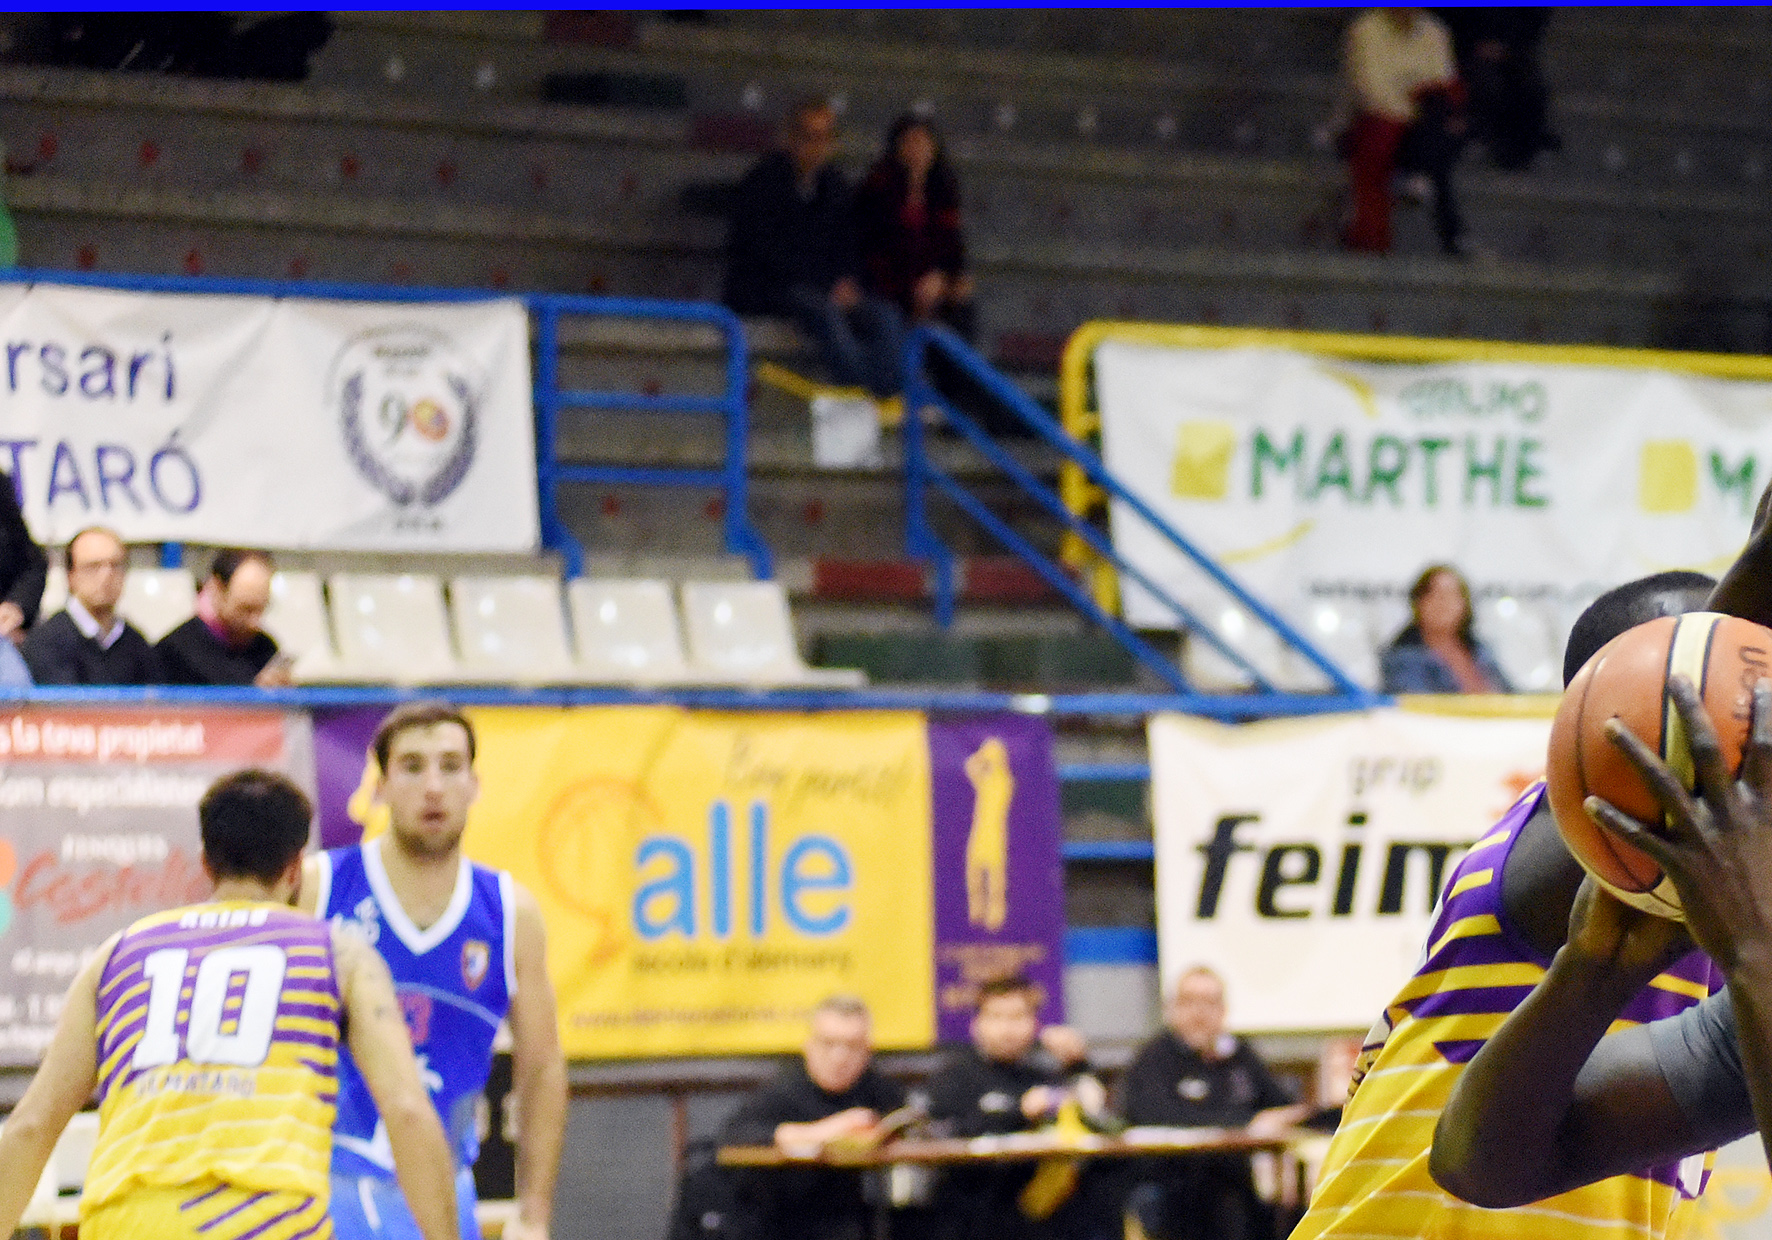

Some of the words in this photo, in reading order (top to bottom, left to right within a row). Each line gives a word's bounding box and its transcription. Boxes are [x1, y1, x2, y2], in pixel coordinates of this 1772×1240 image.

[5, 329, 178, 401] rsari
[1248, 426, 1553, 509] MARTHE
[633, 800, 853, 939] alle
[132, 944, 288, 1069] 10
